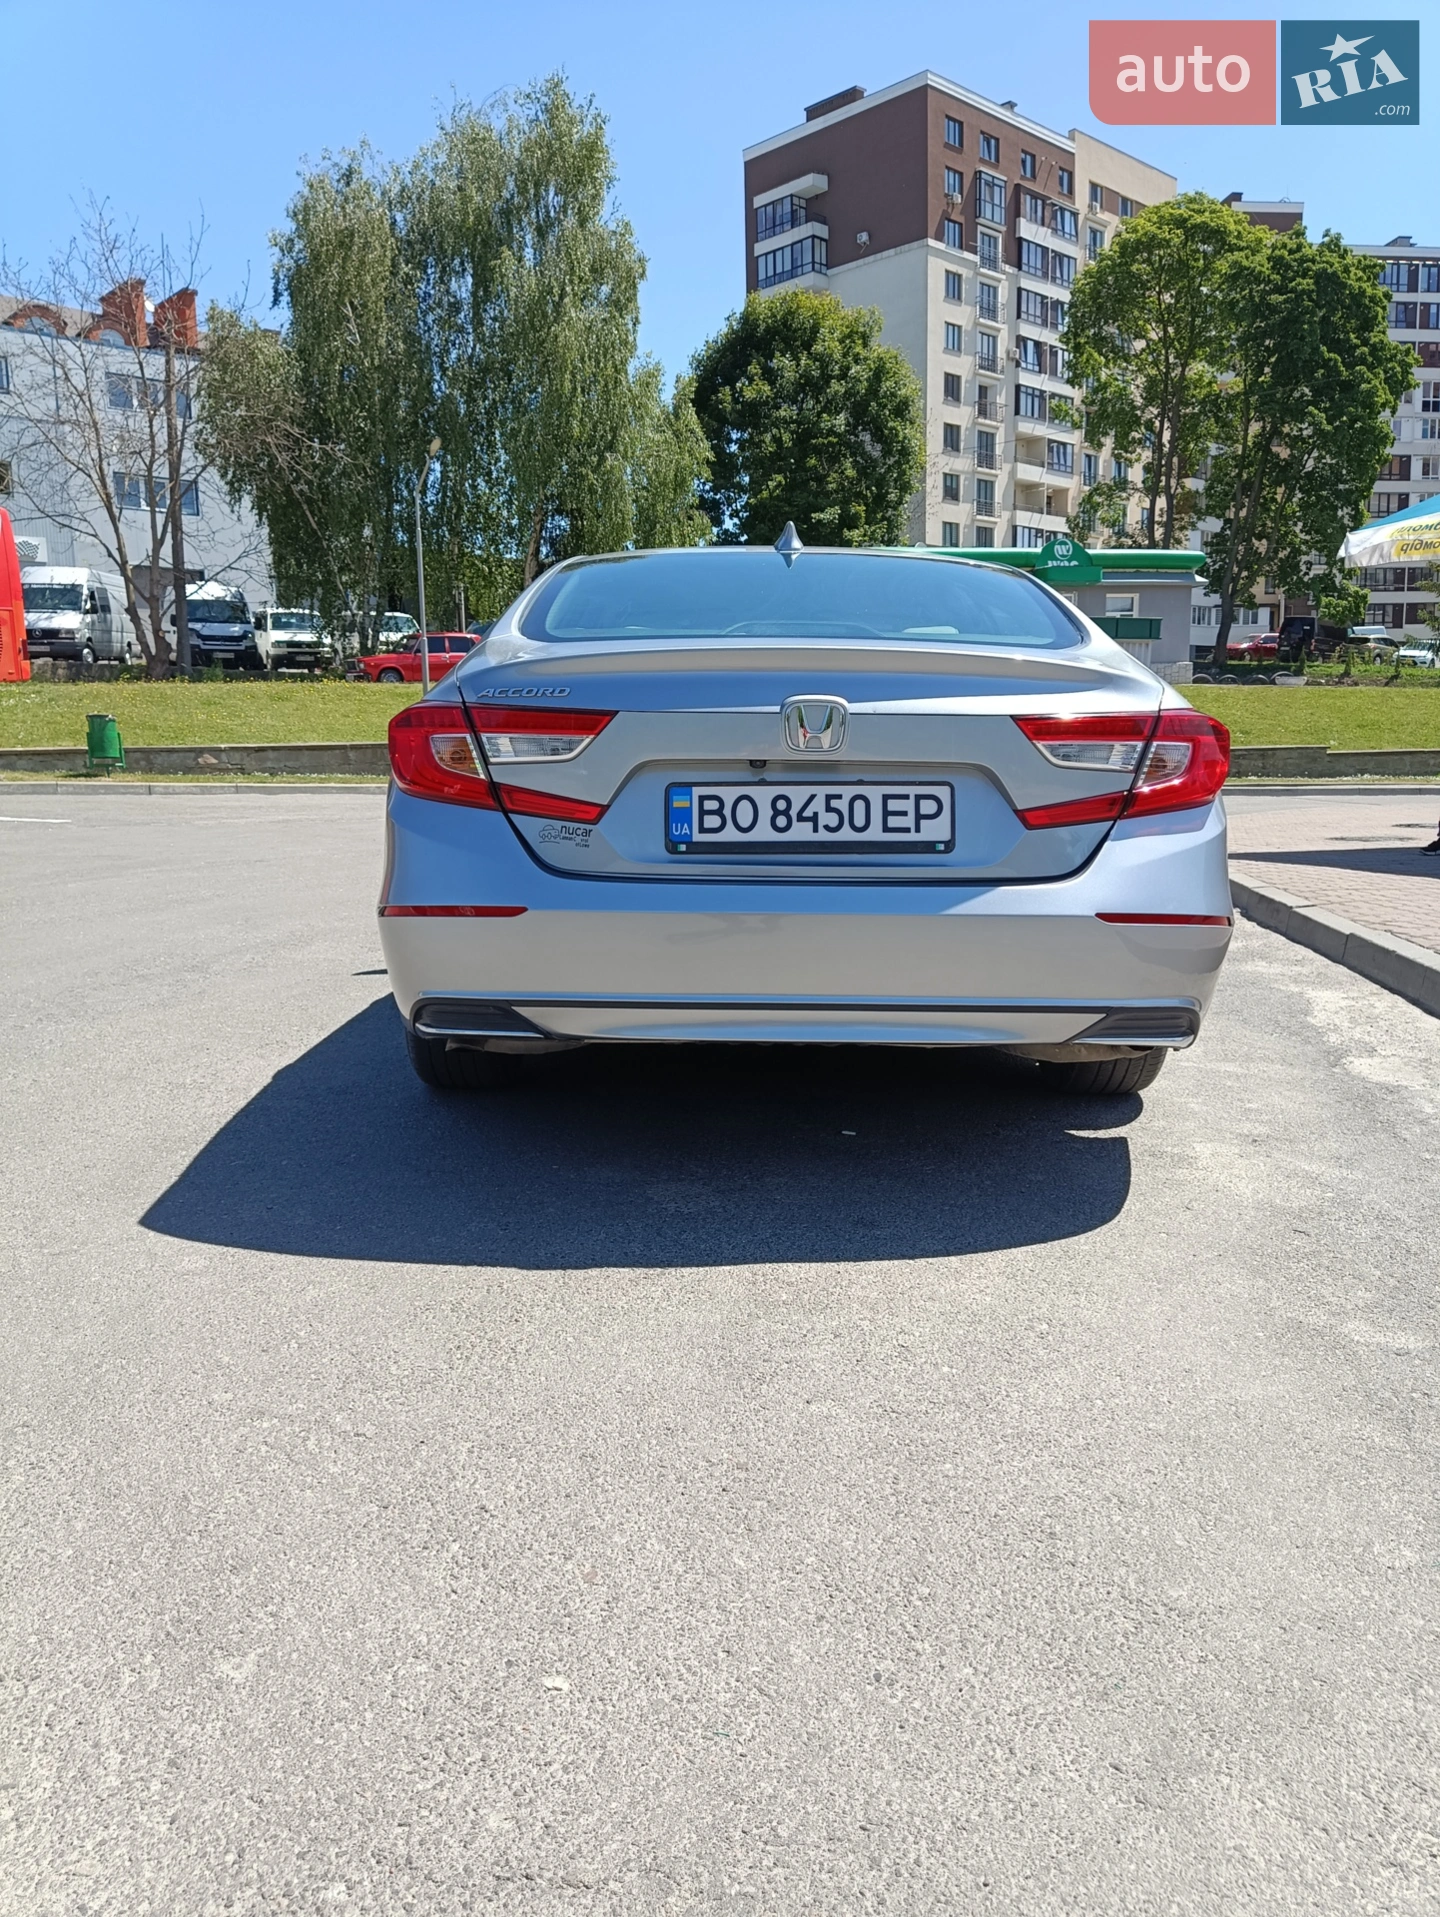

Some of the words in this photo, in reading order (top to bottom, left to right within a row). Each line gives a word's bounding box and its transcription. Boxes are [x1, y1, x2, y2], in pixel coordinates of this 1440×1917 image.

[477, 687, 571, 698] ACCORD
[698, 794, 759, 834] BO
[770, 794, 871, 834] 8450
[882, 794, 944, 834] EP
[560, 825, 593, 838] nucar
[672, 823, 690, 836] UA
